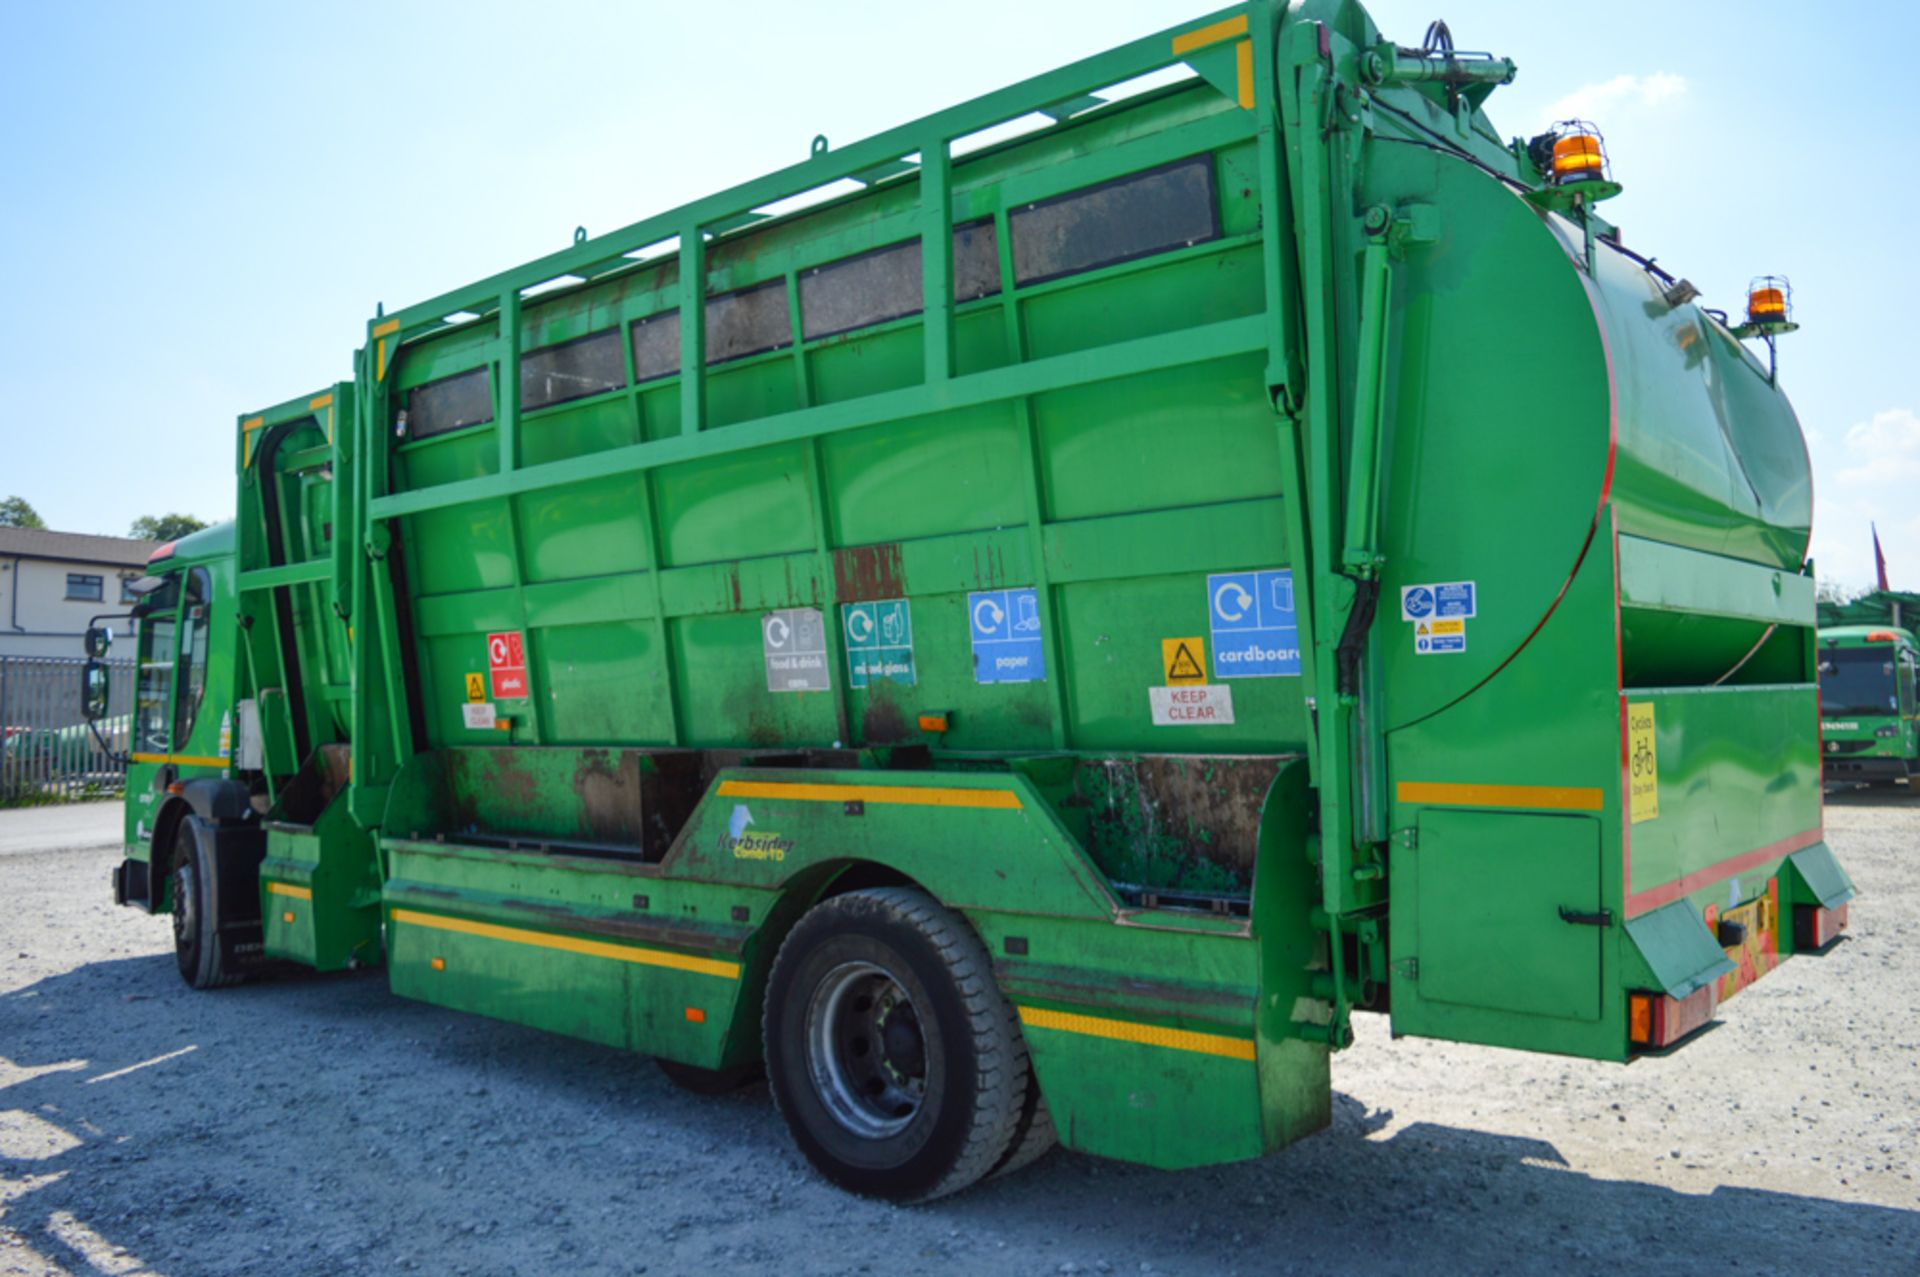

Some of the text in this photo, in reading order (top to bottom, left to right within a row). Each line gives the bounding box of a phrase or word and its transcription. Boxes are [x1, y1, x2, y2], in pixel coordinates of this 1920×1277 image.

[996, 656, 1029, 670] paper
[1170, 690, 1207, 704] KEEP
[1168, 706, 1216, 720] CLEAR
[717, 832, 795, 853] Kerbsider
